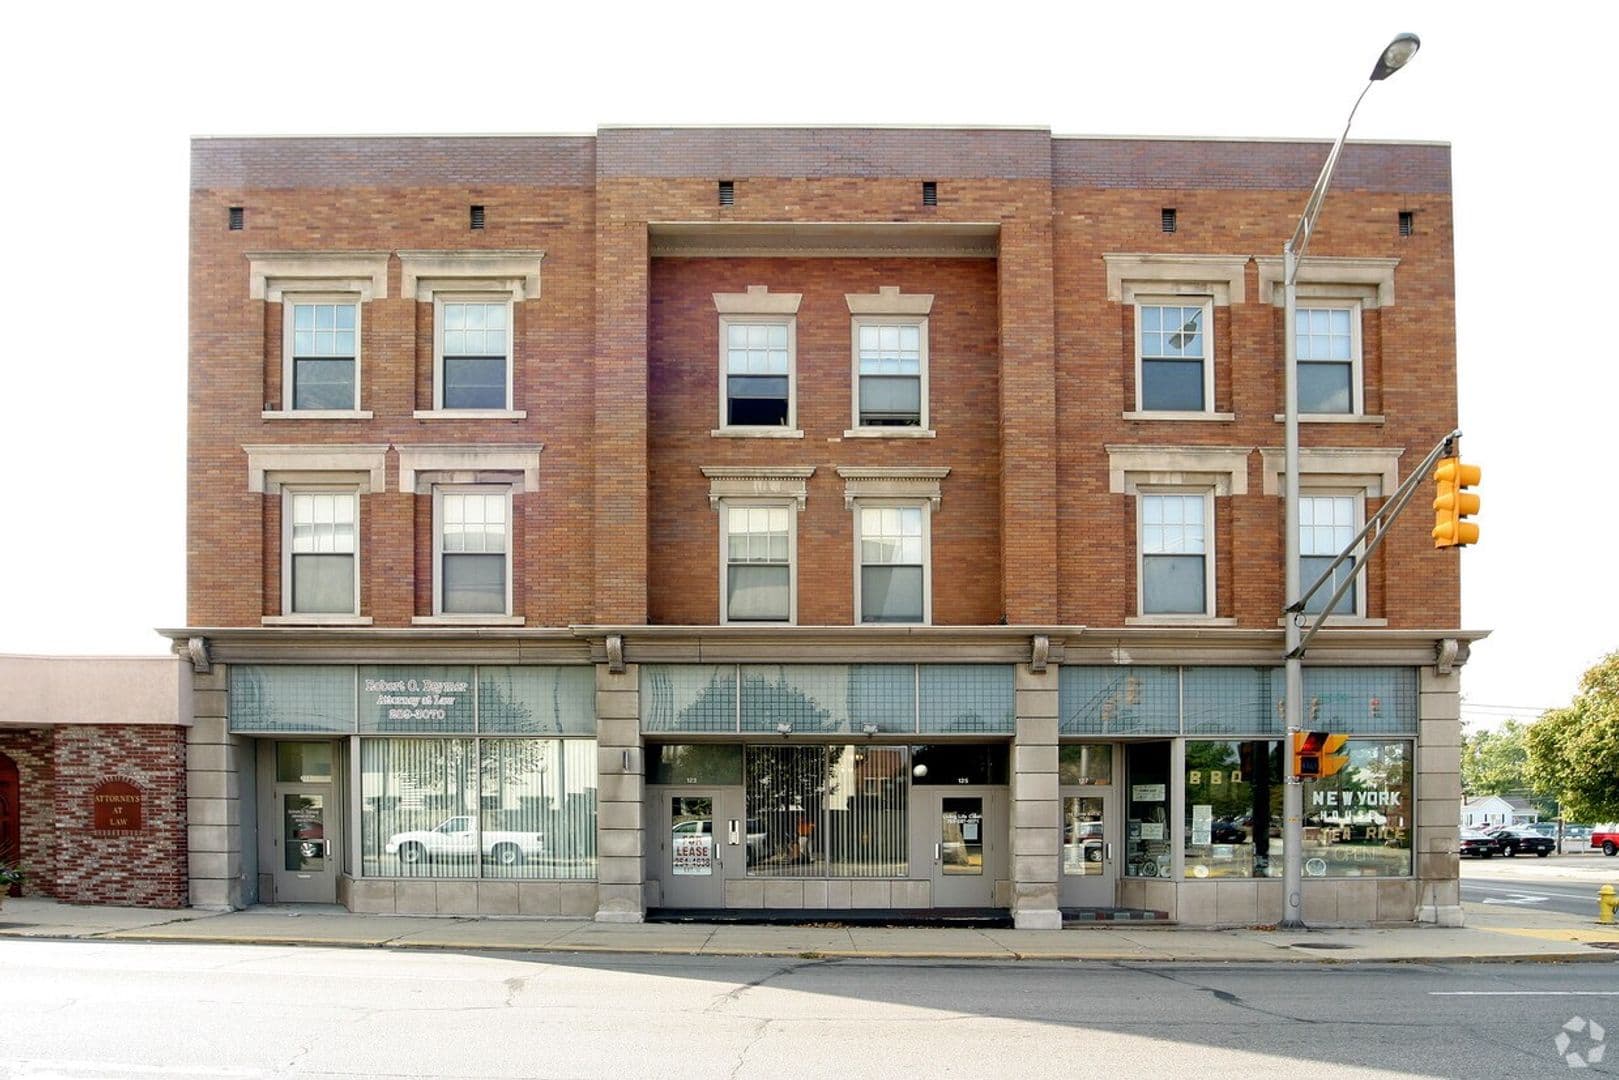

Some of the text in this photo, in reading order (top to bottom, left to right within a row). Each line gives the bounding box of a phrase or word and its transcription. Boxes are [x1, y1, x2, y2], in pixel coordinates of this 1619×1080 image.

[365, 679, 405, 692] Robert
[376, 694, 455, 707] Attorney at Law
[1312, 790, 1401, 806] NEW YORK
[1365, 826, 1407, 840] RICE
[676, 846, 708, 857] LEASE
